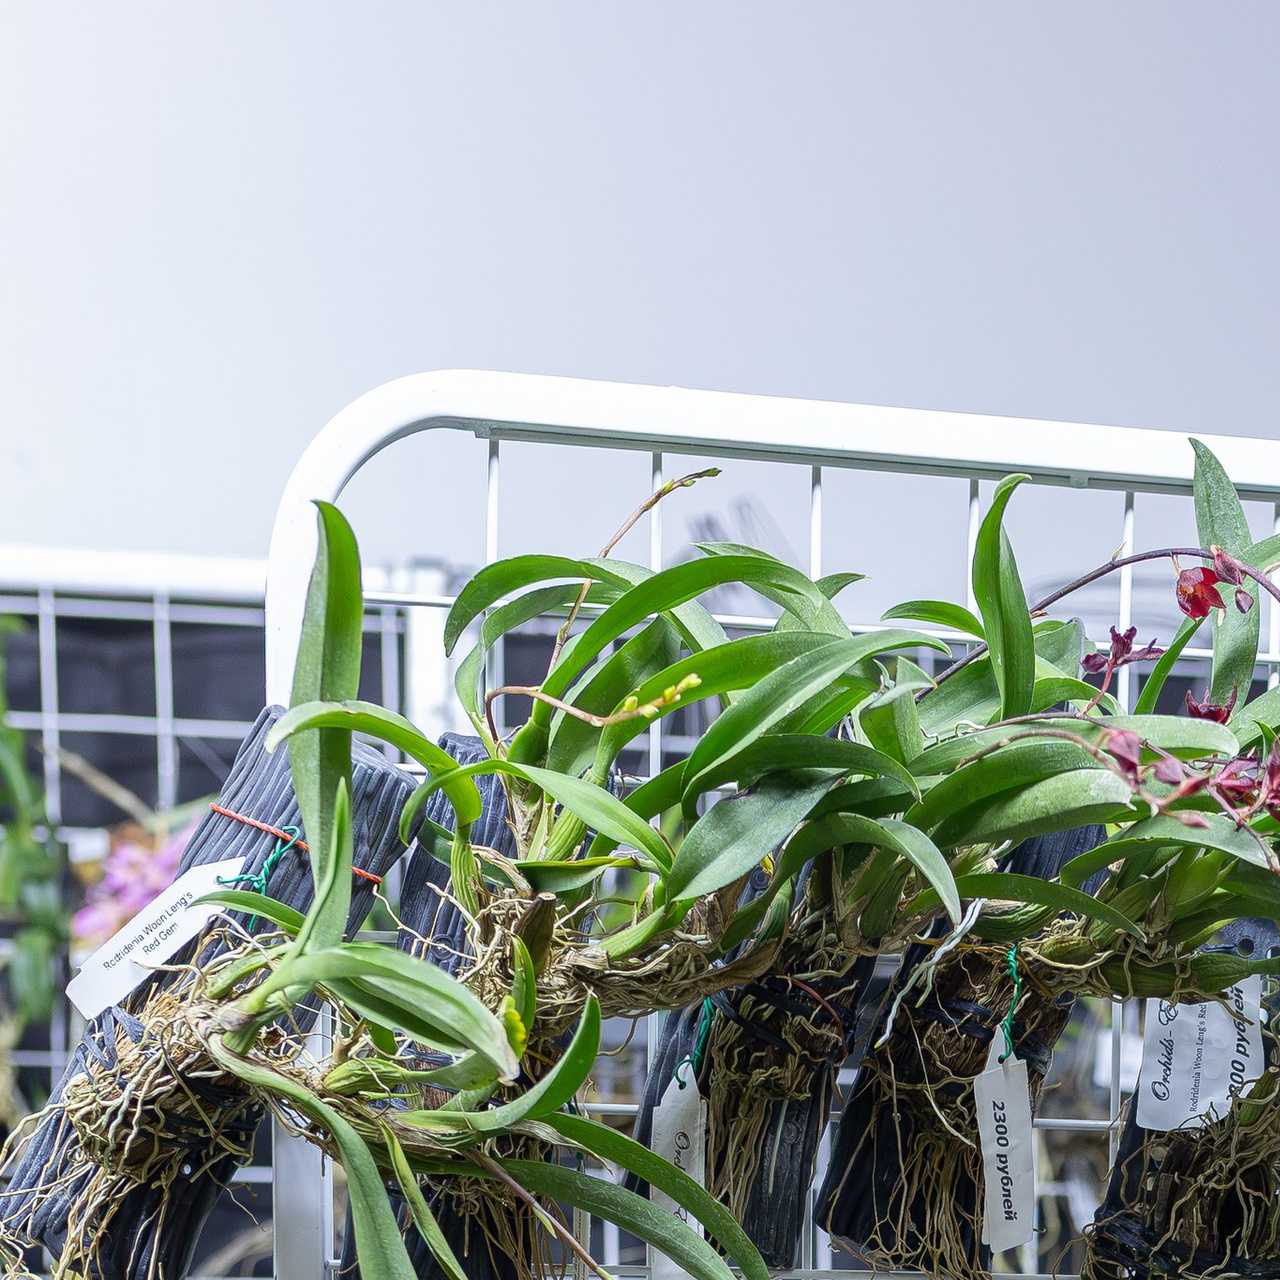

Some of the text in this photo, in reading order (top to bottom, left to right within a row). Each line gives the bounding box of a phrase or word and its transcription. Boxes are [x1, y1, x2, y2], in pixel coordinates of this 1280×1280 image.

[142, 914, 168, 943] Woon
[165, 891, 194, 922] Leng's
[142, 922, 180, 955] Red Gem
[1190, 1004, 1207, 1112] Rodridenia Woon Leng's Red
[992, 1100, 1018, 1221] 2300 рублей
